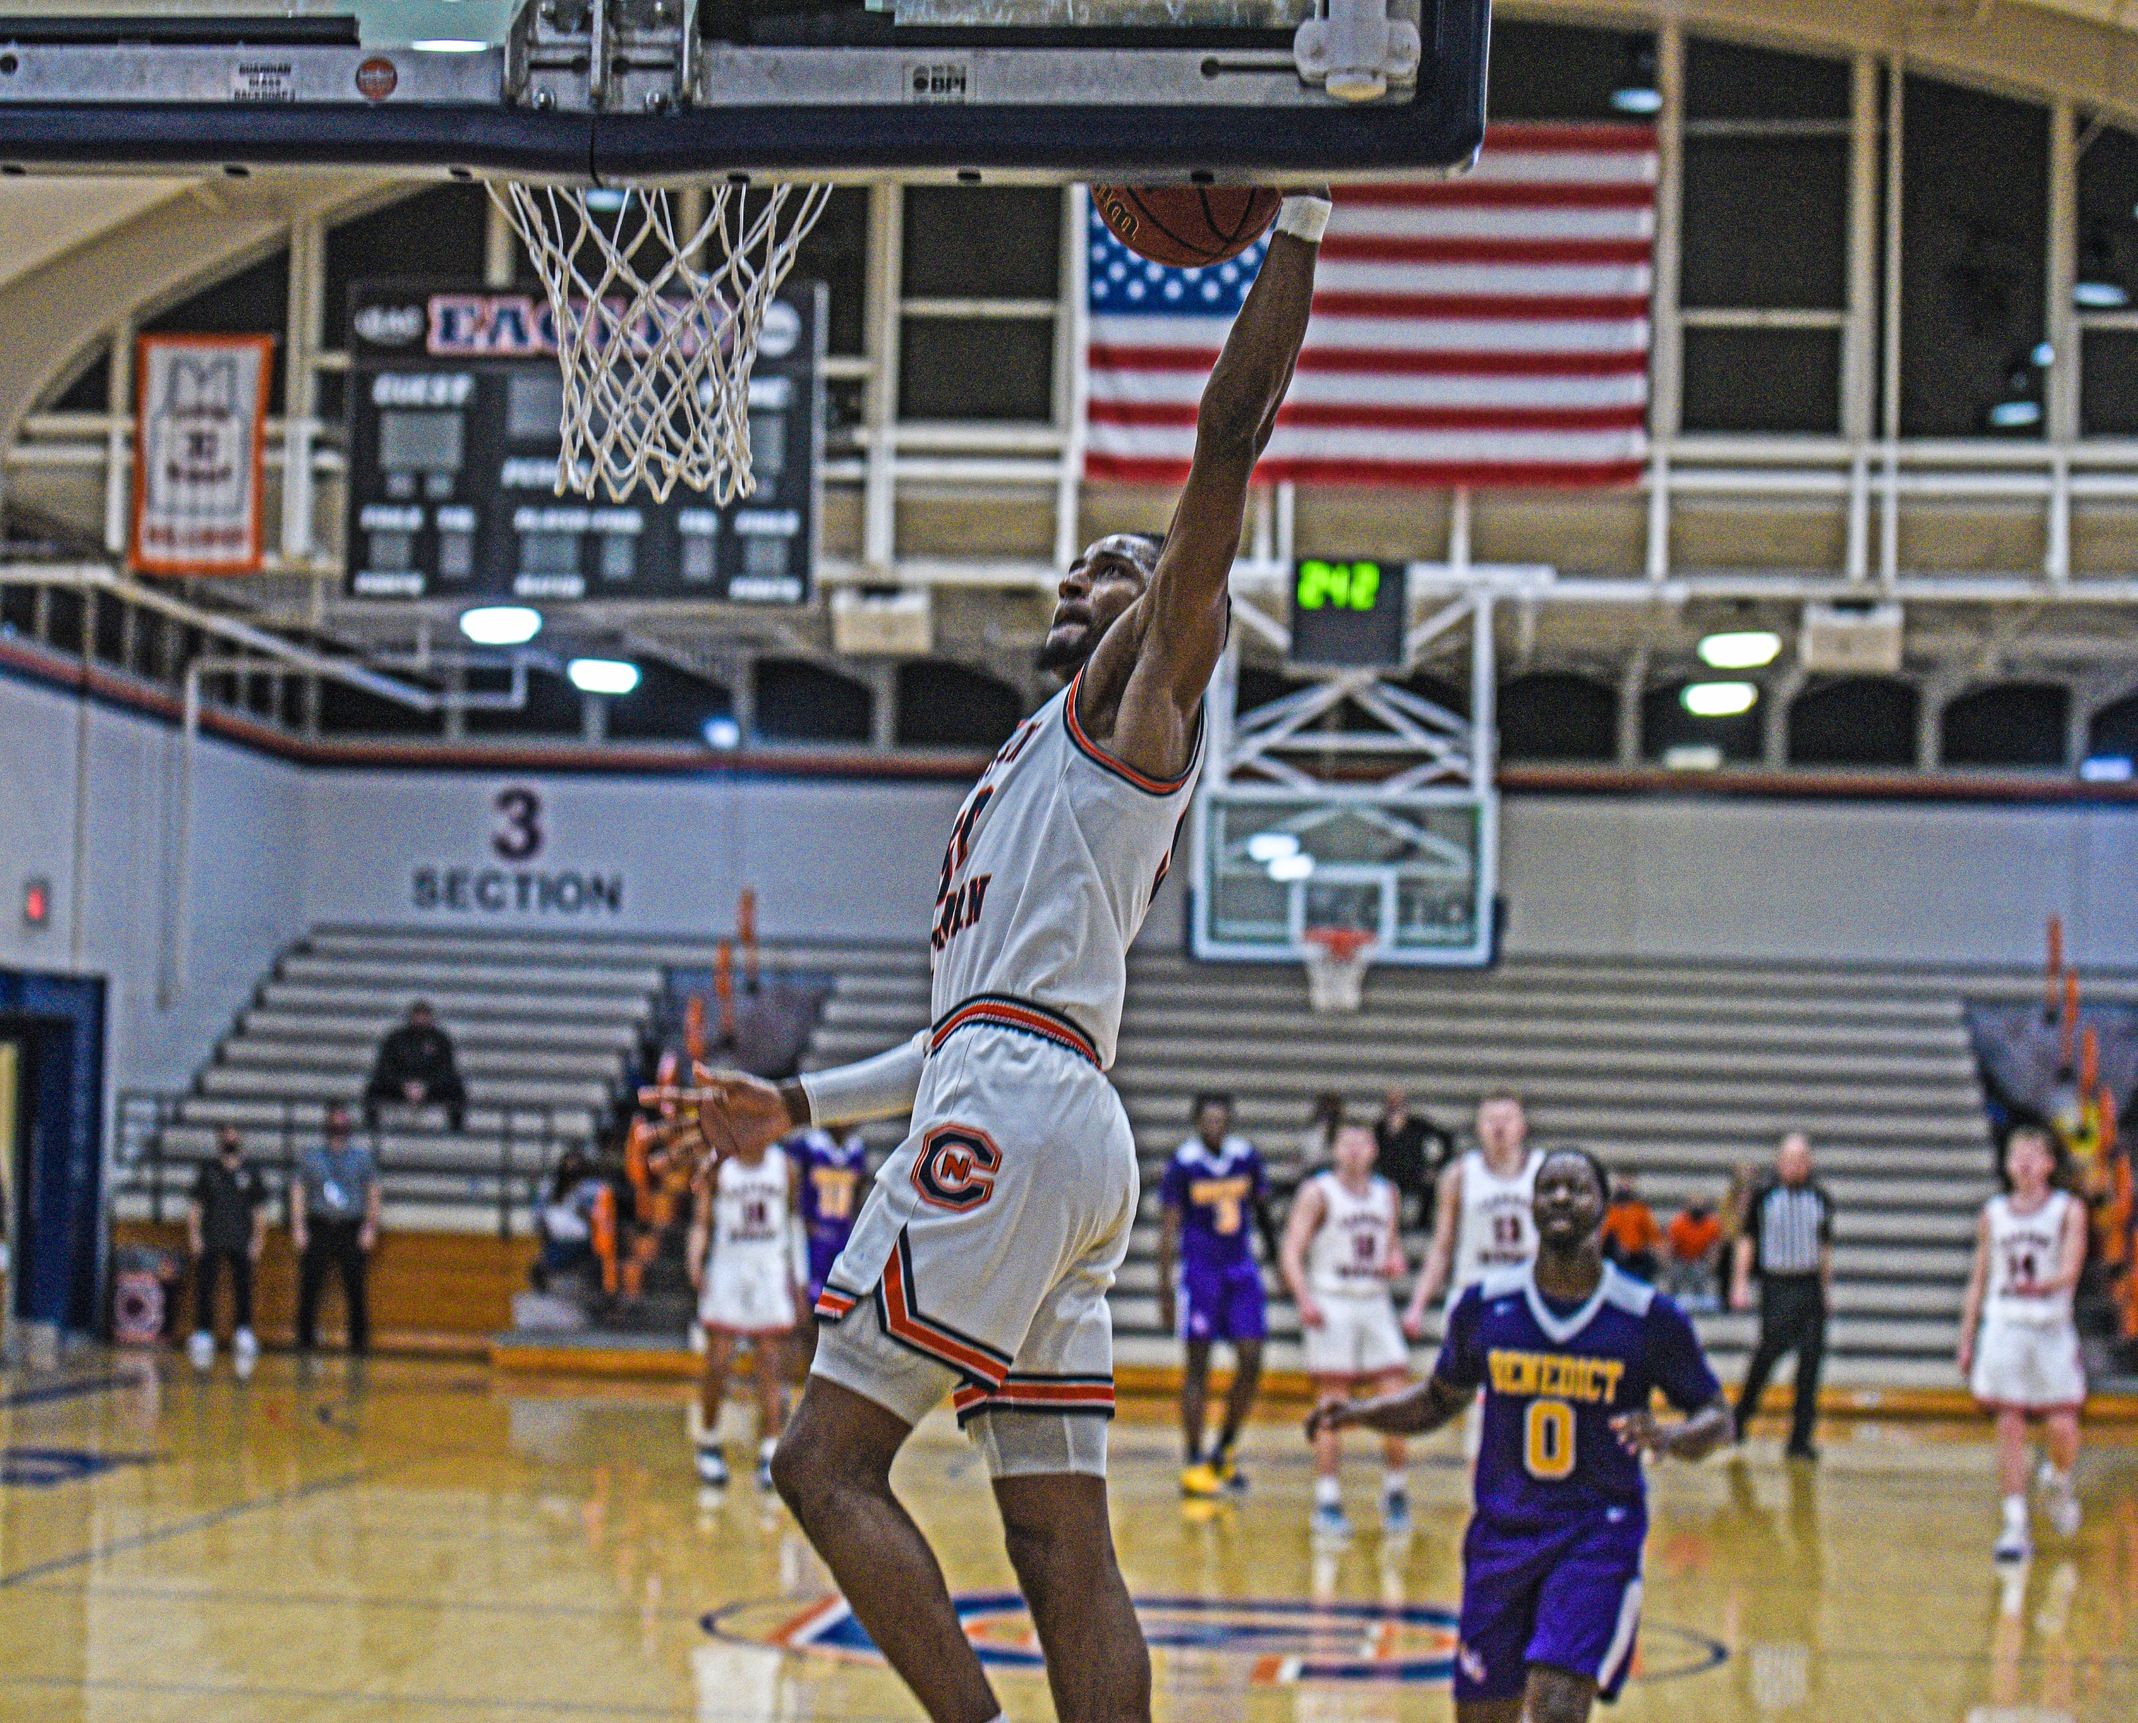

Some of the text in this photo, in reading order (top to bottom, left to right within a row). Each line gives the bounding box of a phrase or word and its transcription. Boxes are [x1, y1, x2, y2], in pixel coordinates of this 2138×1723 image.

[494, 785, 543, 861] 3
[412, 867, 623, 913] SECTION
[1487, 1348, 1625, 1403] BENEDICT
[1523, 1397, 1577, 1480] 0
